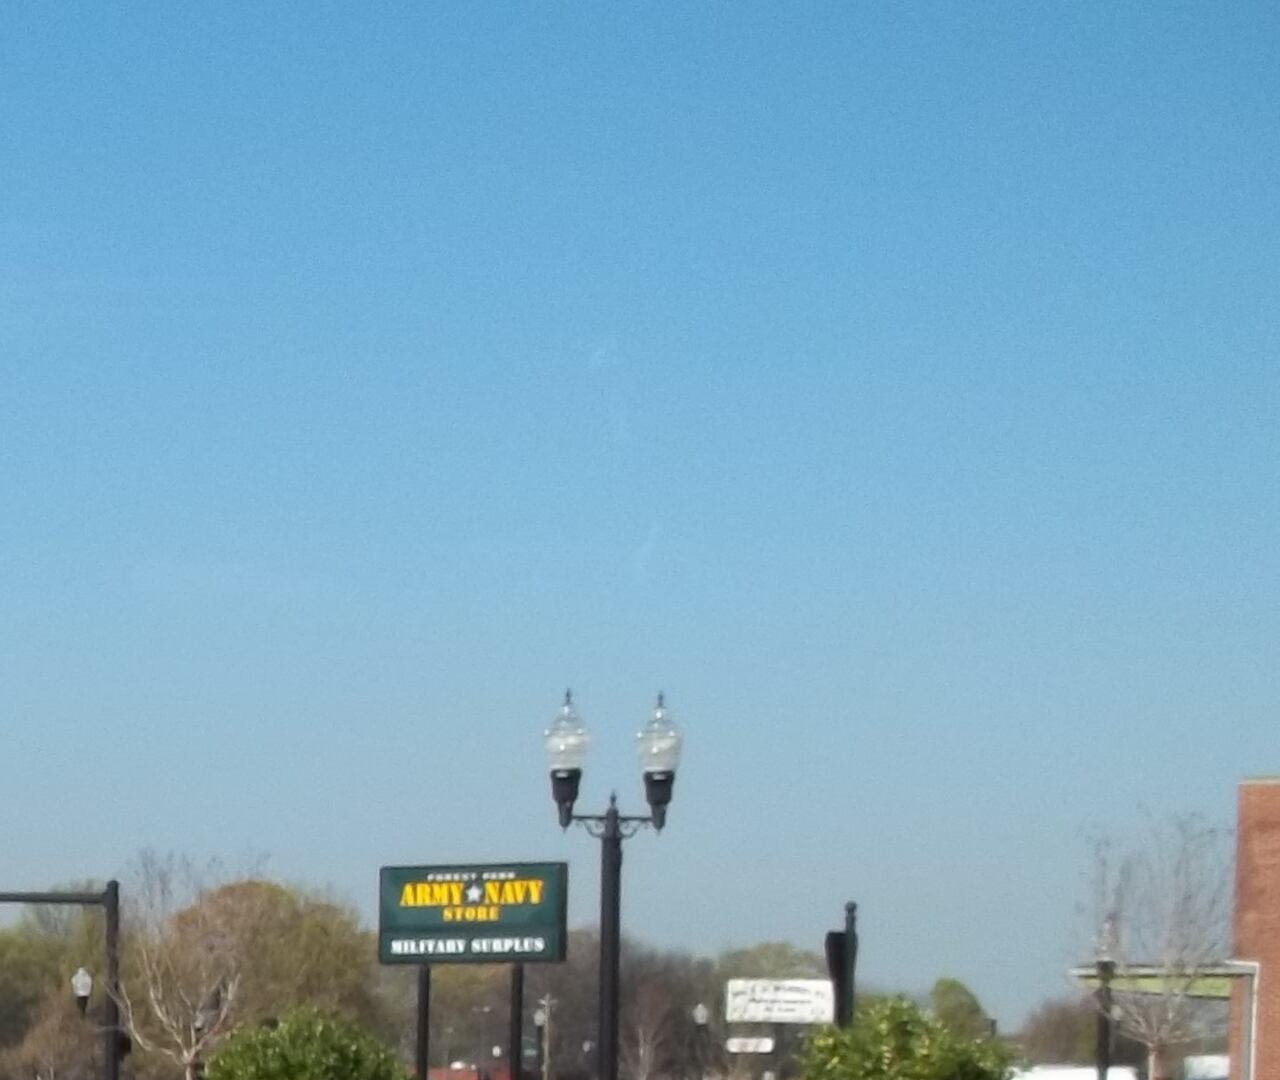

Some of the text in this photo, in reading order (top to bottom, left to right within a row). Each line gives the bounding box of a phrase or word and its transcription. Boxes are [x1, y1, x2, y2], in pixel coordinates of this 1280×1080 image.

[399, 878, 544, 907] ARMY NAVY
[442, 906, 500, 922] STORE
[391, 937, 545, 954] MILITARY SURPLUS
